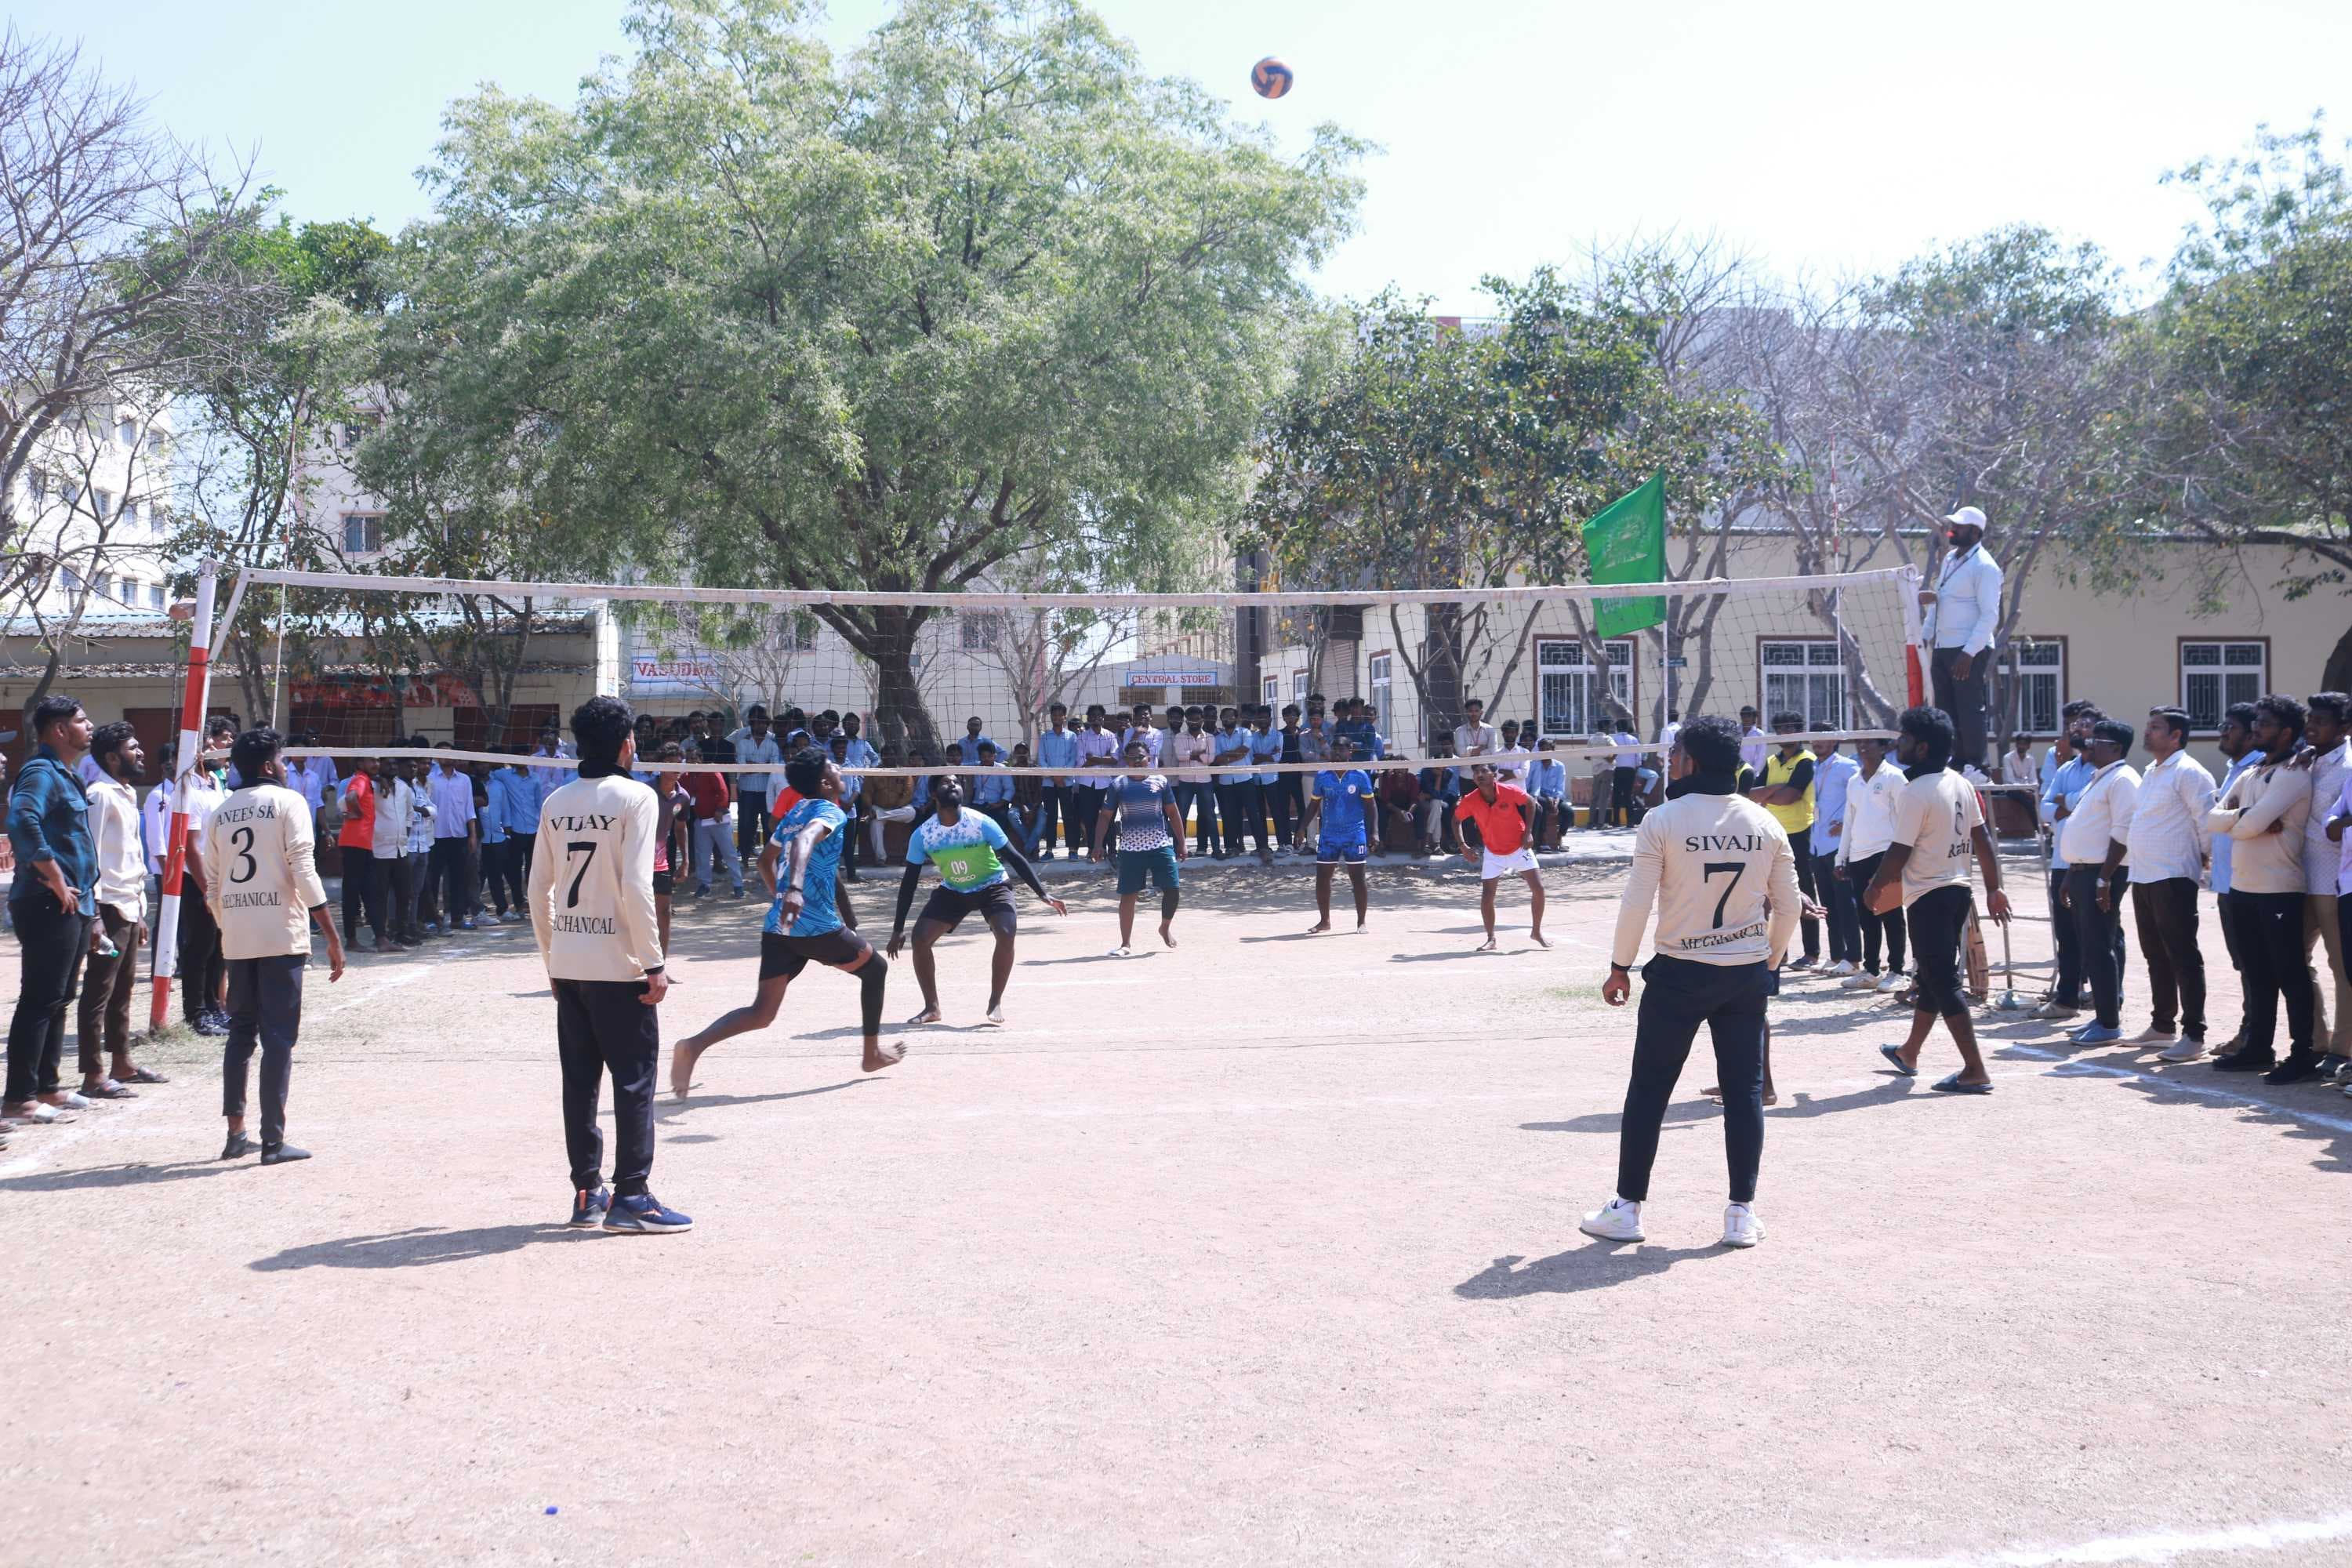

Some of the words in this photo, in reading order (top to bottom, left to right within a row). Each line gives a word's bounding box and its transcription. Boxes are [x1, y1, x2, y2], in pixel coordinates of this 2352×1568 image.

[1131, 675, 1178, 684] CENTRAL
[1180, 675, 1211, 684] STORE
[257, 804, 276, 819] SK
[550, 815, 617, 832] VIJAY
[1358, 845, 1365, 855] 17
[1686, 834, 1762, 852] SIVAJI
[230, 826, 257, 884] 3
[567, 841, 597, 908] 7
[950, 860, 967, 875] 09
[1704, 862, 1746, 929] 7
[553, 914, 615, 935] ECHANICAL
